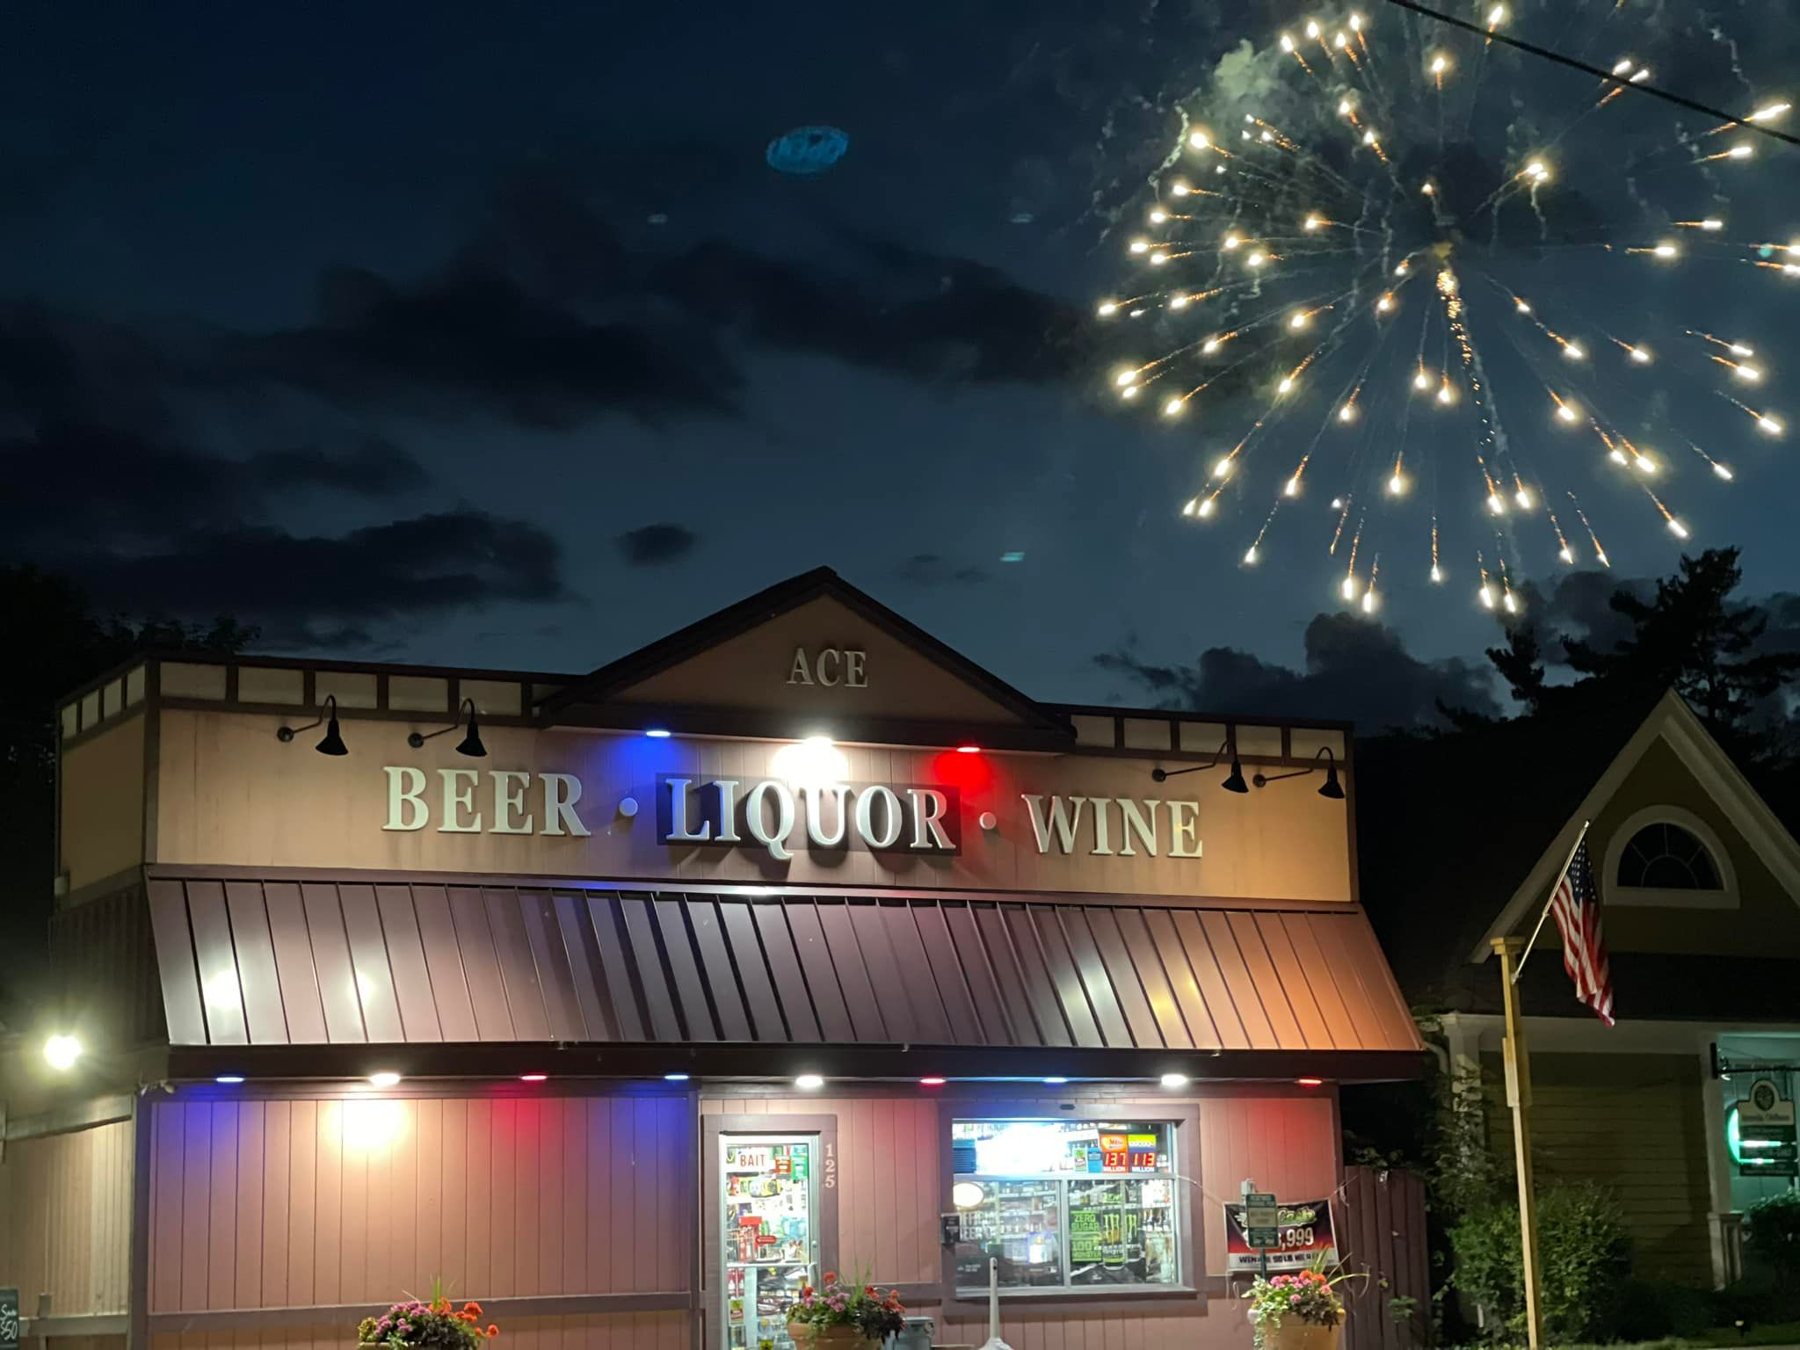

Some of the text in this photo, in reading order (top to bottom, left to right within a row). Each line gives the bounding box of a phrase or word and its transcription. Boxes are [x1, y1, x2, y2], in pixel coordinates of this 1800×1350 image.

[787, 647, 869, 689] ACE
[381, 765, 1204, 862] BEER LIQUOR WINE
[740, 1154, 765, 1167] BAIT
[824, 1142, 837, 1189] 125
[1104, 1152, 1126, 1166] 137
[1133, 1152, 1155, 1167] 113
[1074, 1213, 1096, 1223] ZERO
[1071, 1222, 1100, 1232] SUGAR
